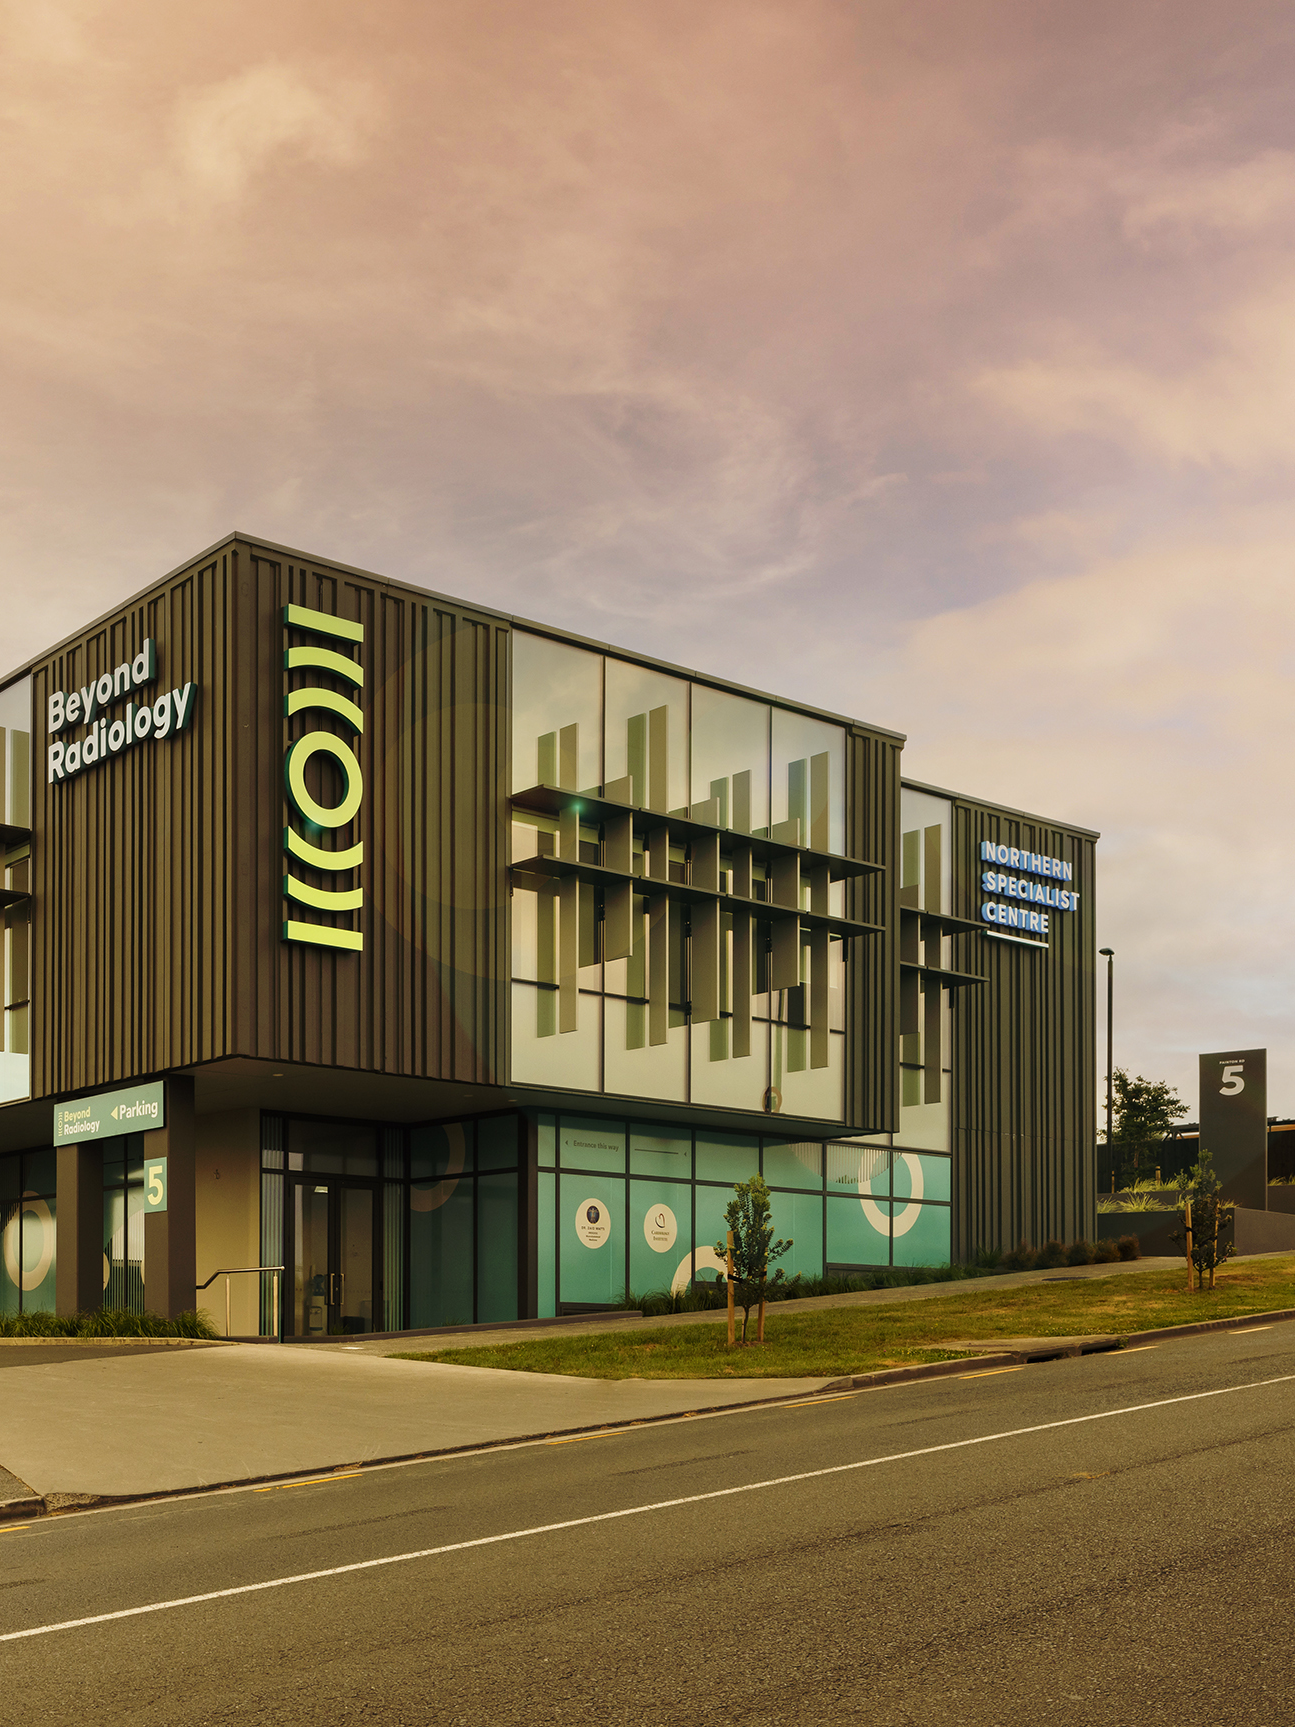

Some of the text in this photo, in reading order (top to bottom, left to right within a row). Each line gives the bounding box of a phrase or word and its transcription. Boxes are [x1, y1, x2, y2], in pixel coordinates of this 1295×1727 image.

[48, 638, 156, 734] Beyond
[48, 682, 196, 784] Radiology
[981, 840, 1072, 881] NORTHERN
[982, 871, 1080, 911] SPECIALIST
[982, 901, 1049, 934] CENTRE
[1219, 1065, 1245, 1096] 5
[64, 1106, 91, 1123] Beyond
[119, 1100, 158, 1120] Parking
[64, 1120, 100, 1136] Radiology
[573, 1140, 596, 1149] Entrance
[147, 1165, 164, 1206] 5
